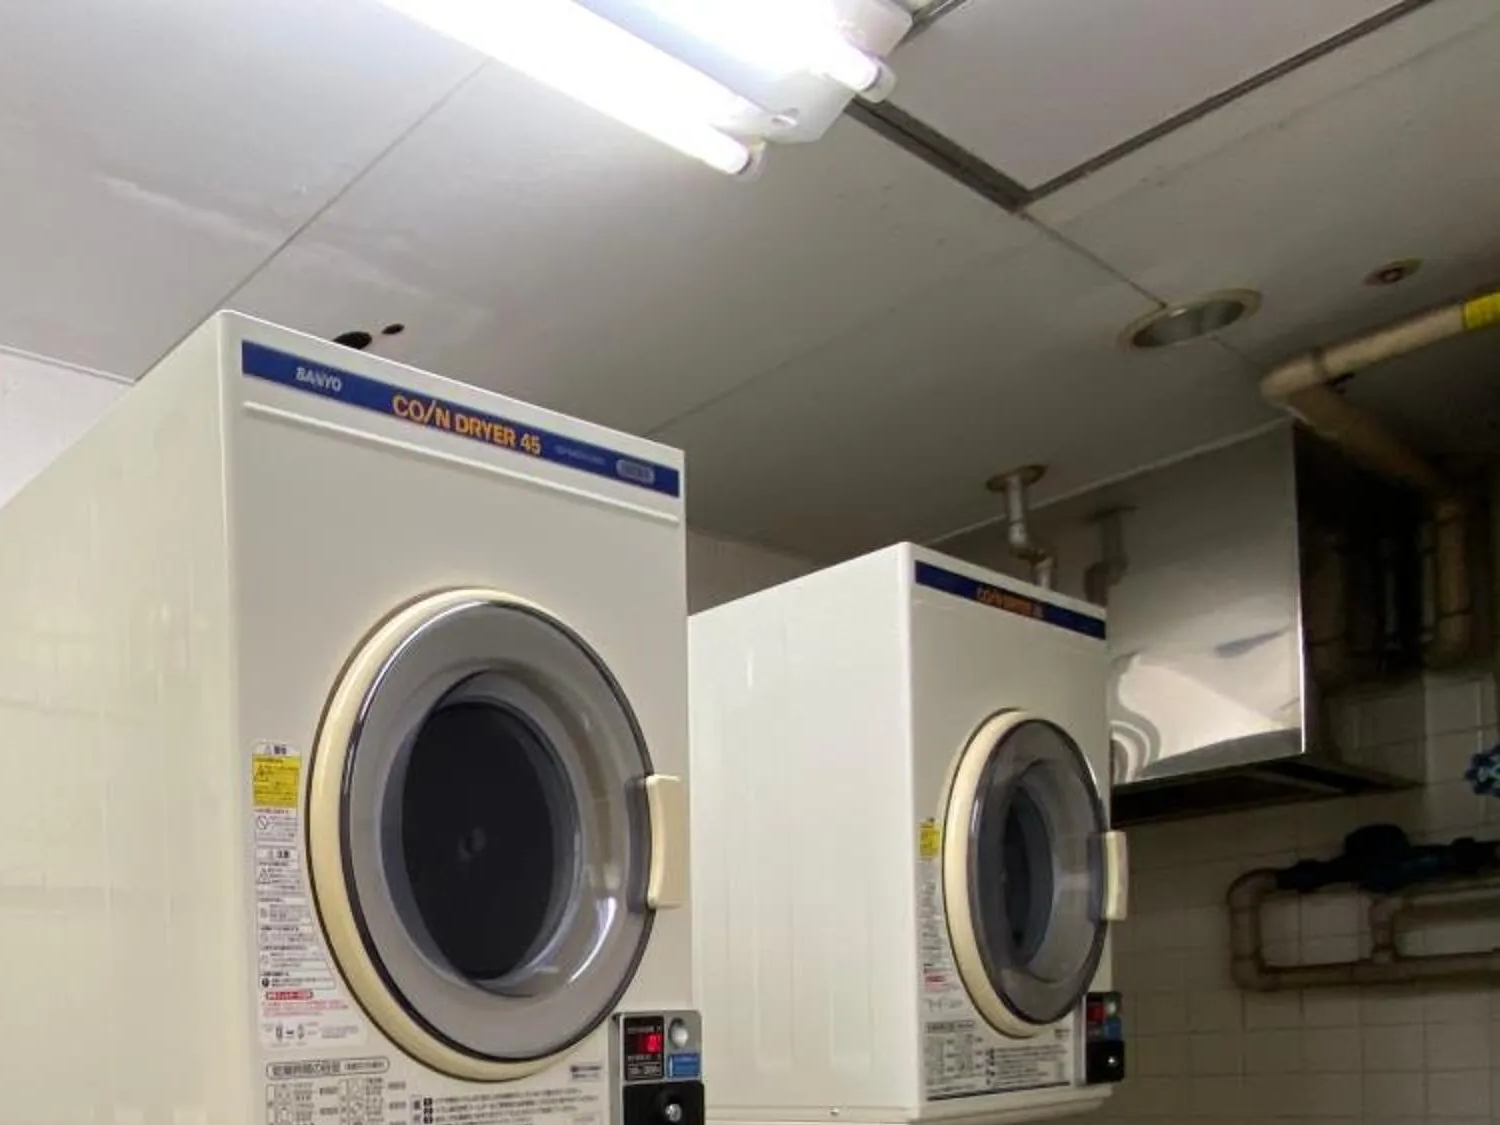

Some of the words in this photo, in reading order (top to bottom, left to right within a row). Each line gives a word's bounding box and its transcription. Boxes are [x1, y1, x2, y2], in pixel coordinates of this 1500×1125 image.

[296, 366, 343, 392] SANYO
[454, 414, 516, 447] DRYER
[520, 432, 542, 455] 45
